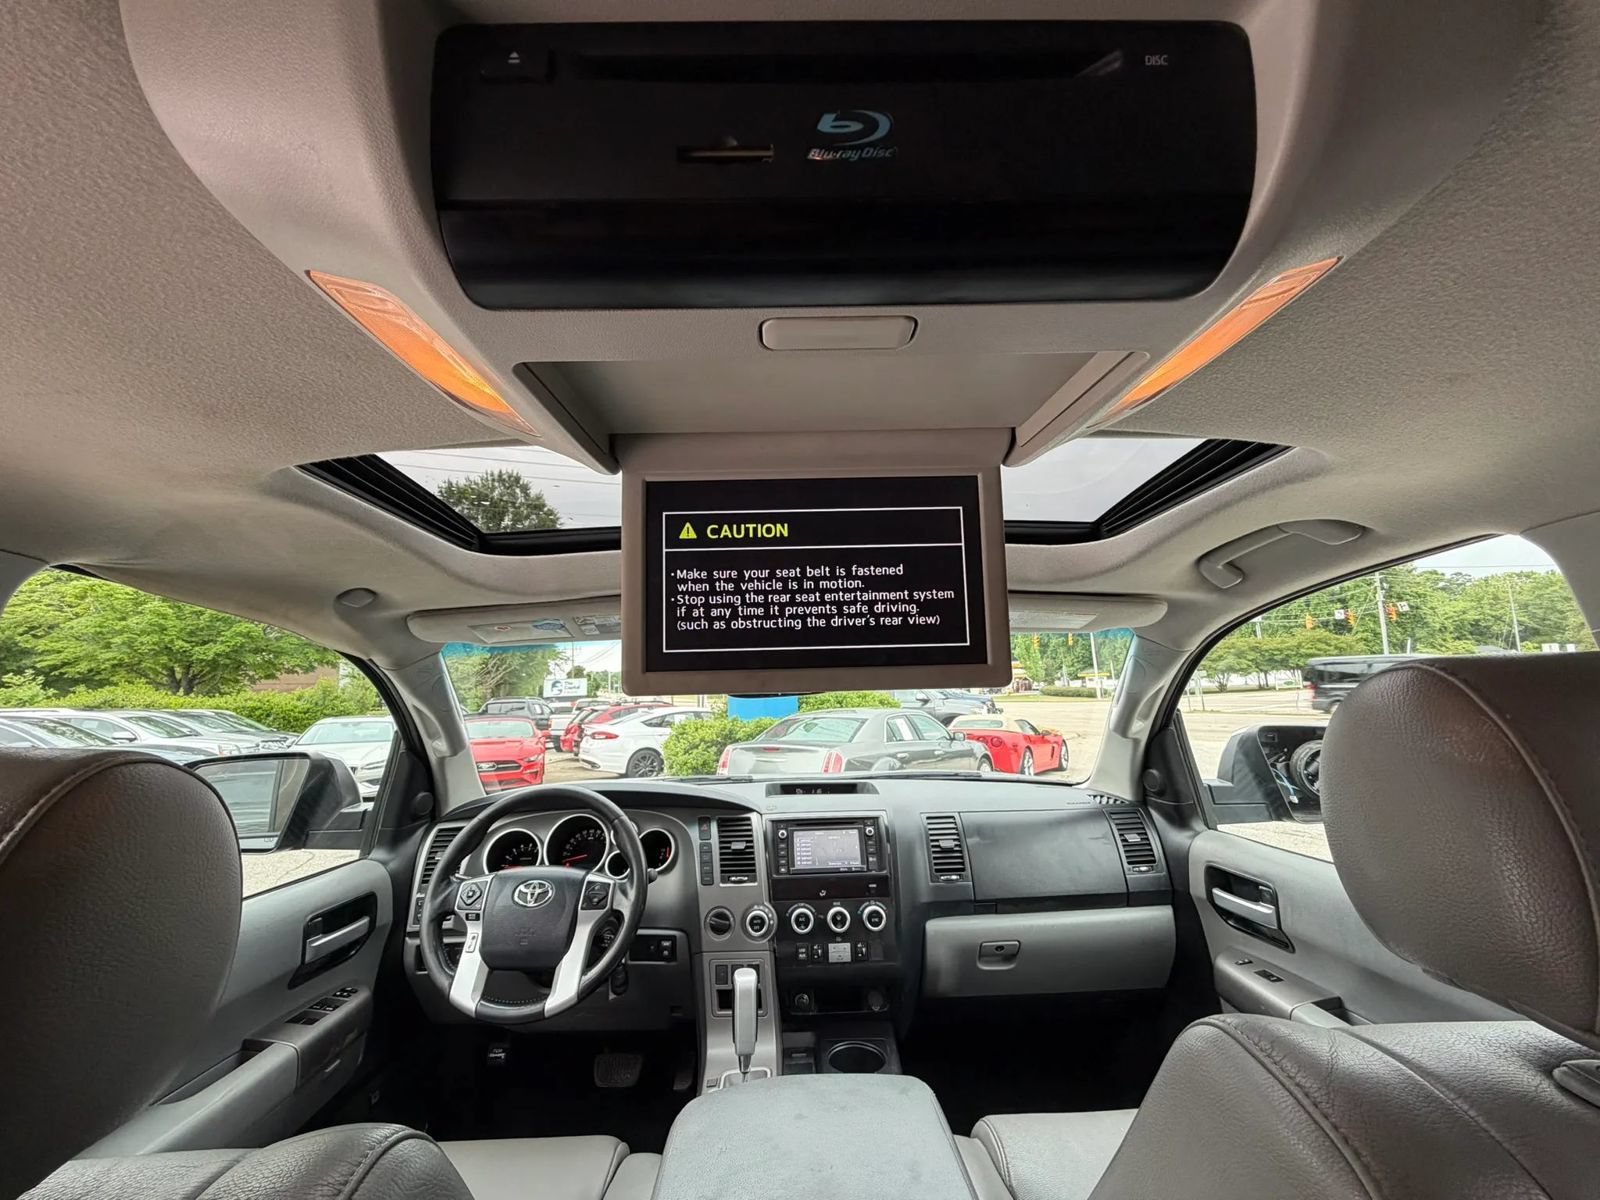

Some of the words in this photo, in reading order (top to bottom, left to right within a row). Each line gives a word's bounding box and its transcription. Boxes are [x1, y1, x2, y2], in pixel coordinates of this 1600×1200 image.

[1144, 54, 1169, 66] DISC
[861, 146, 894, 158] Disc
[706, 523, 789, 539] CAUTION
[677, 568, 708, 579] Make
[713, 569, 738, 579] sure
[744, 568, 770, 580] your
[776, 567, 801, 578] seat
[806, 566, 830, 577] belt
[836, 566, 846, 577] is
[852, 564, 904, 576] fastened
[677, 581, 710, 592] when
[716, 580, 735, 591] the
[740, 580, 783, 591] vehicle
[788, 579, 798, 590] is
[804, 579, 814, 589] in
[819, 578, 865, 589] motion.
[677, 594, 706, 606] Stop
[709, 593, 741, 606] using
[746, 592, 764, 603] the
[768, 593, 790, 602] rear
[796, 592, 821, 602] seat
[825, 590, 909, 601] entertainment
[913, 589, 955, 601] system
[677, 606, 687, 616] if
[692, 606, 705, 616] at
[710, 606, 732, 618] any
[738, 605, 764, 616] time
[770, 605, 779, 615] it
[785, 604, 838, 616] prevents
[843, 603, 869, 614] safe
[874, 602, 920, 615] driving.
[677, 618, 708, 631] (such
[713, 619, 726, 629] as
[731, 617, 802, 630] obstructing
[807, 616, 826, 628] the
[831, 615, 876, 626] driver's
[880, 616, 902, 625] rear
[908, 614, 941, 625] view)
